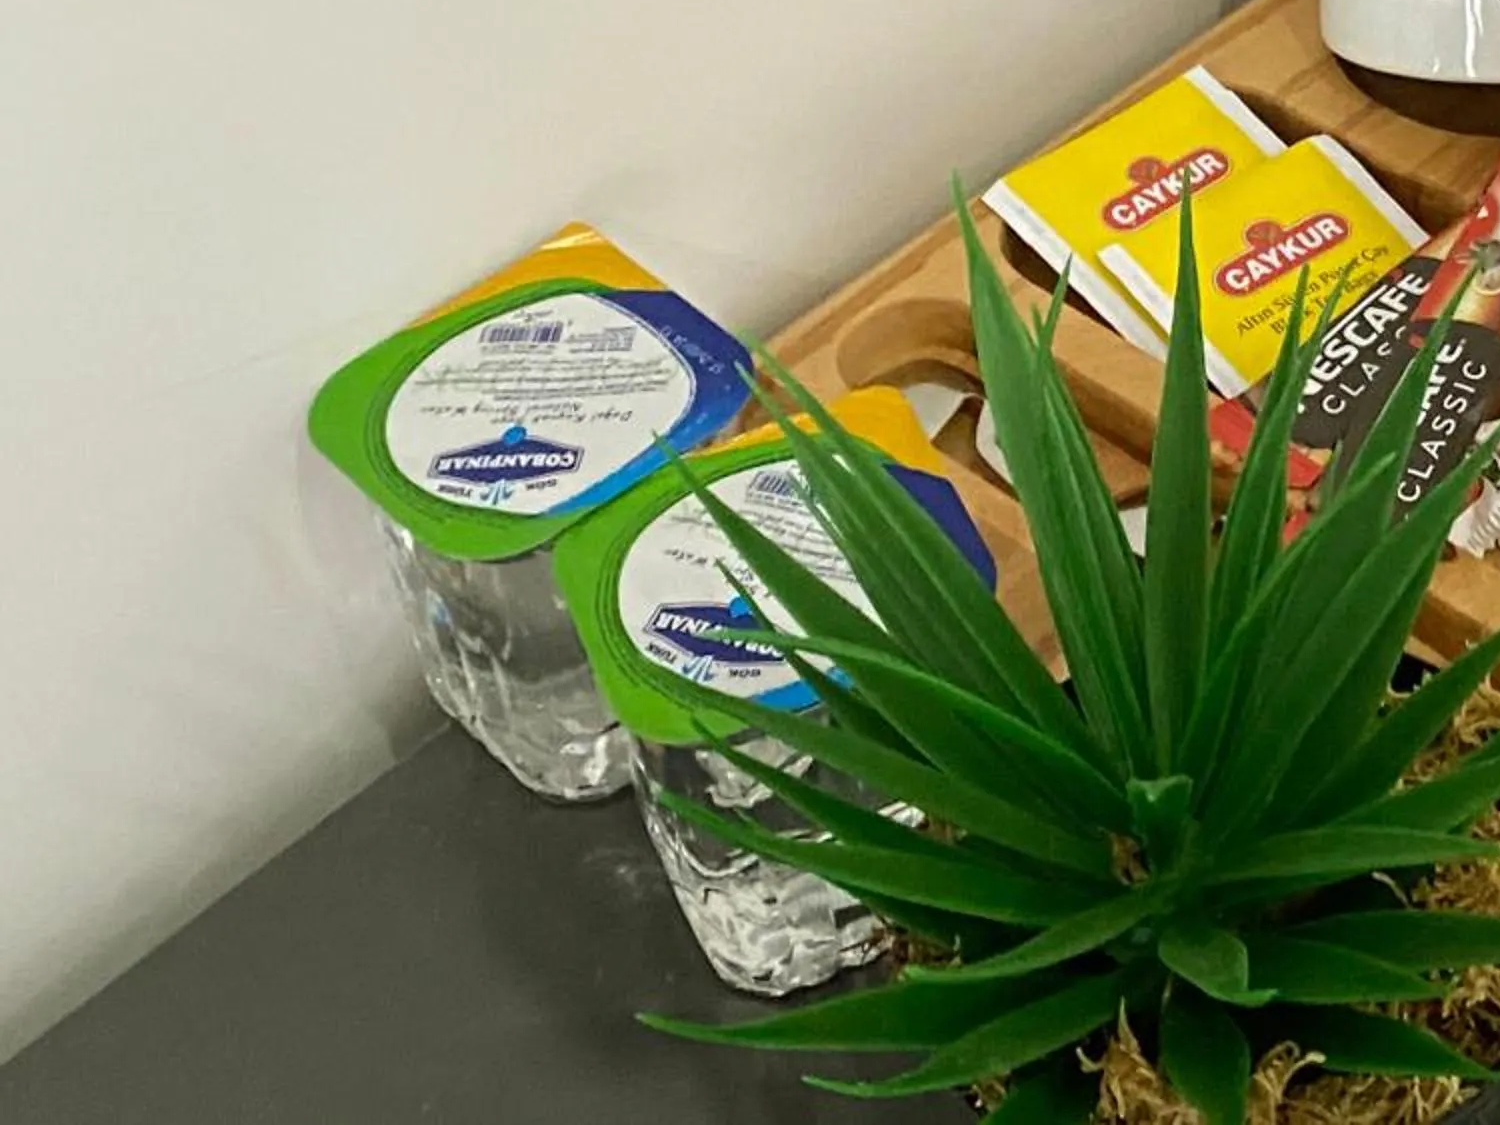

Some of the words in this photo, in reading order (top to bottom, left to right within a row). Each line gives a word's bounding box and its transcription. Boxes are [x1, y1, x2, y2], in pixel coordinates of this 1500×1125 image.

[1225, 217, 1344, 292] ÇAYKUR
[1322, 326, 1407, 414] CLAS
[1397, 360, 1488, 502] CLASSIC
